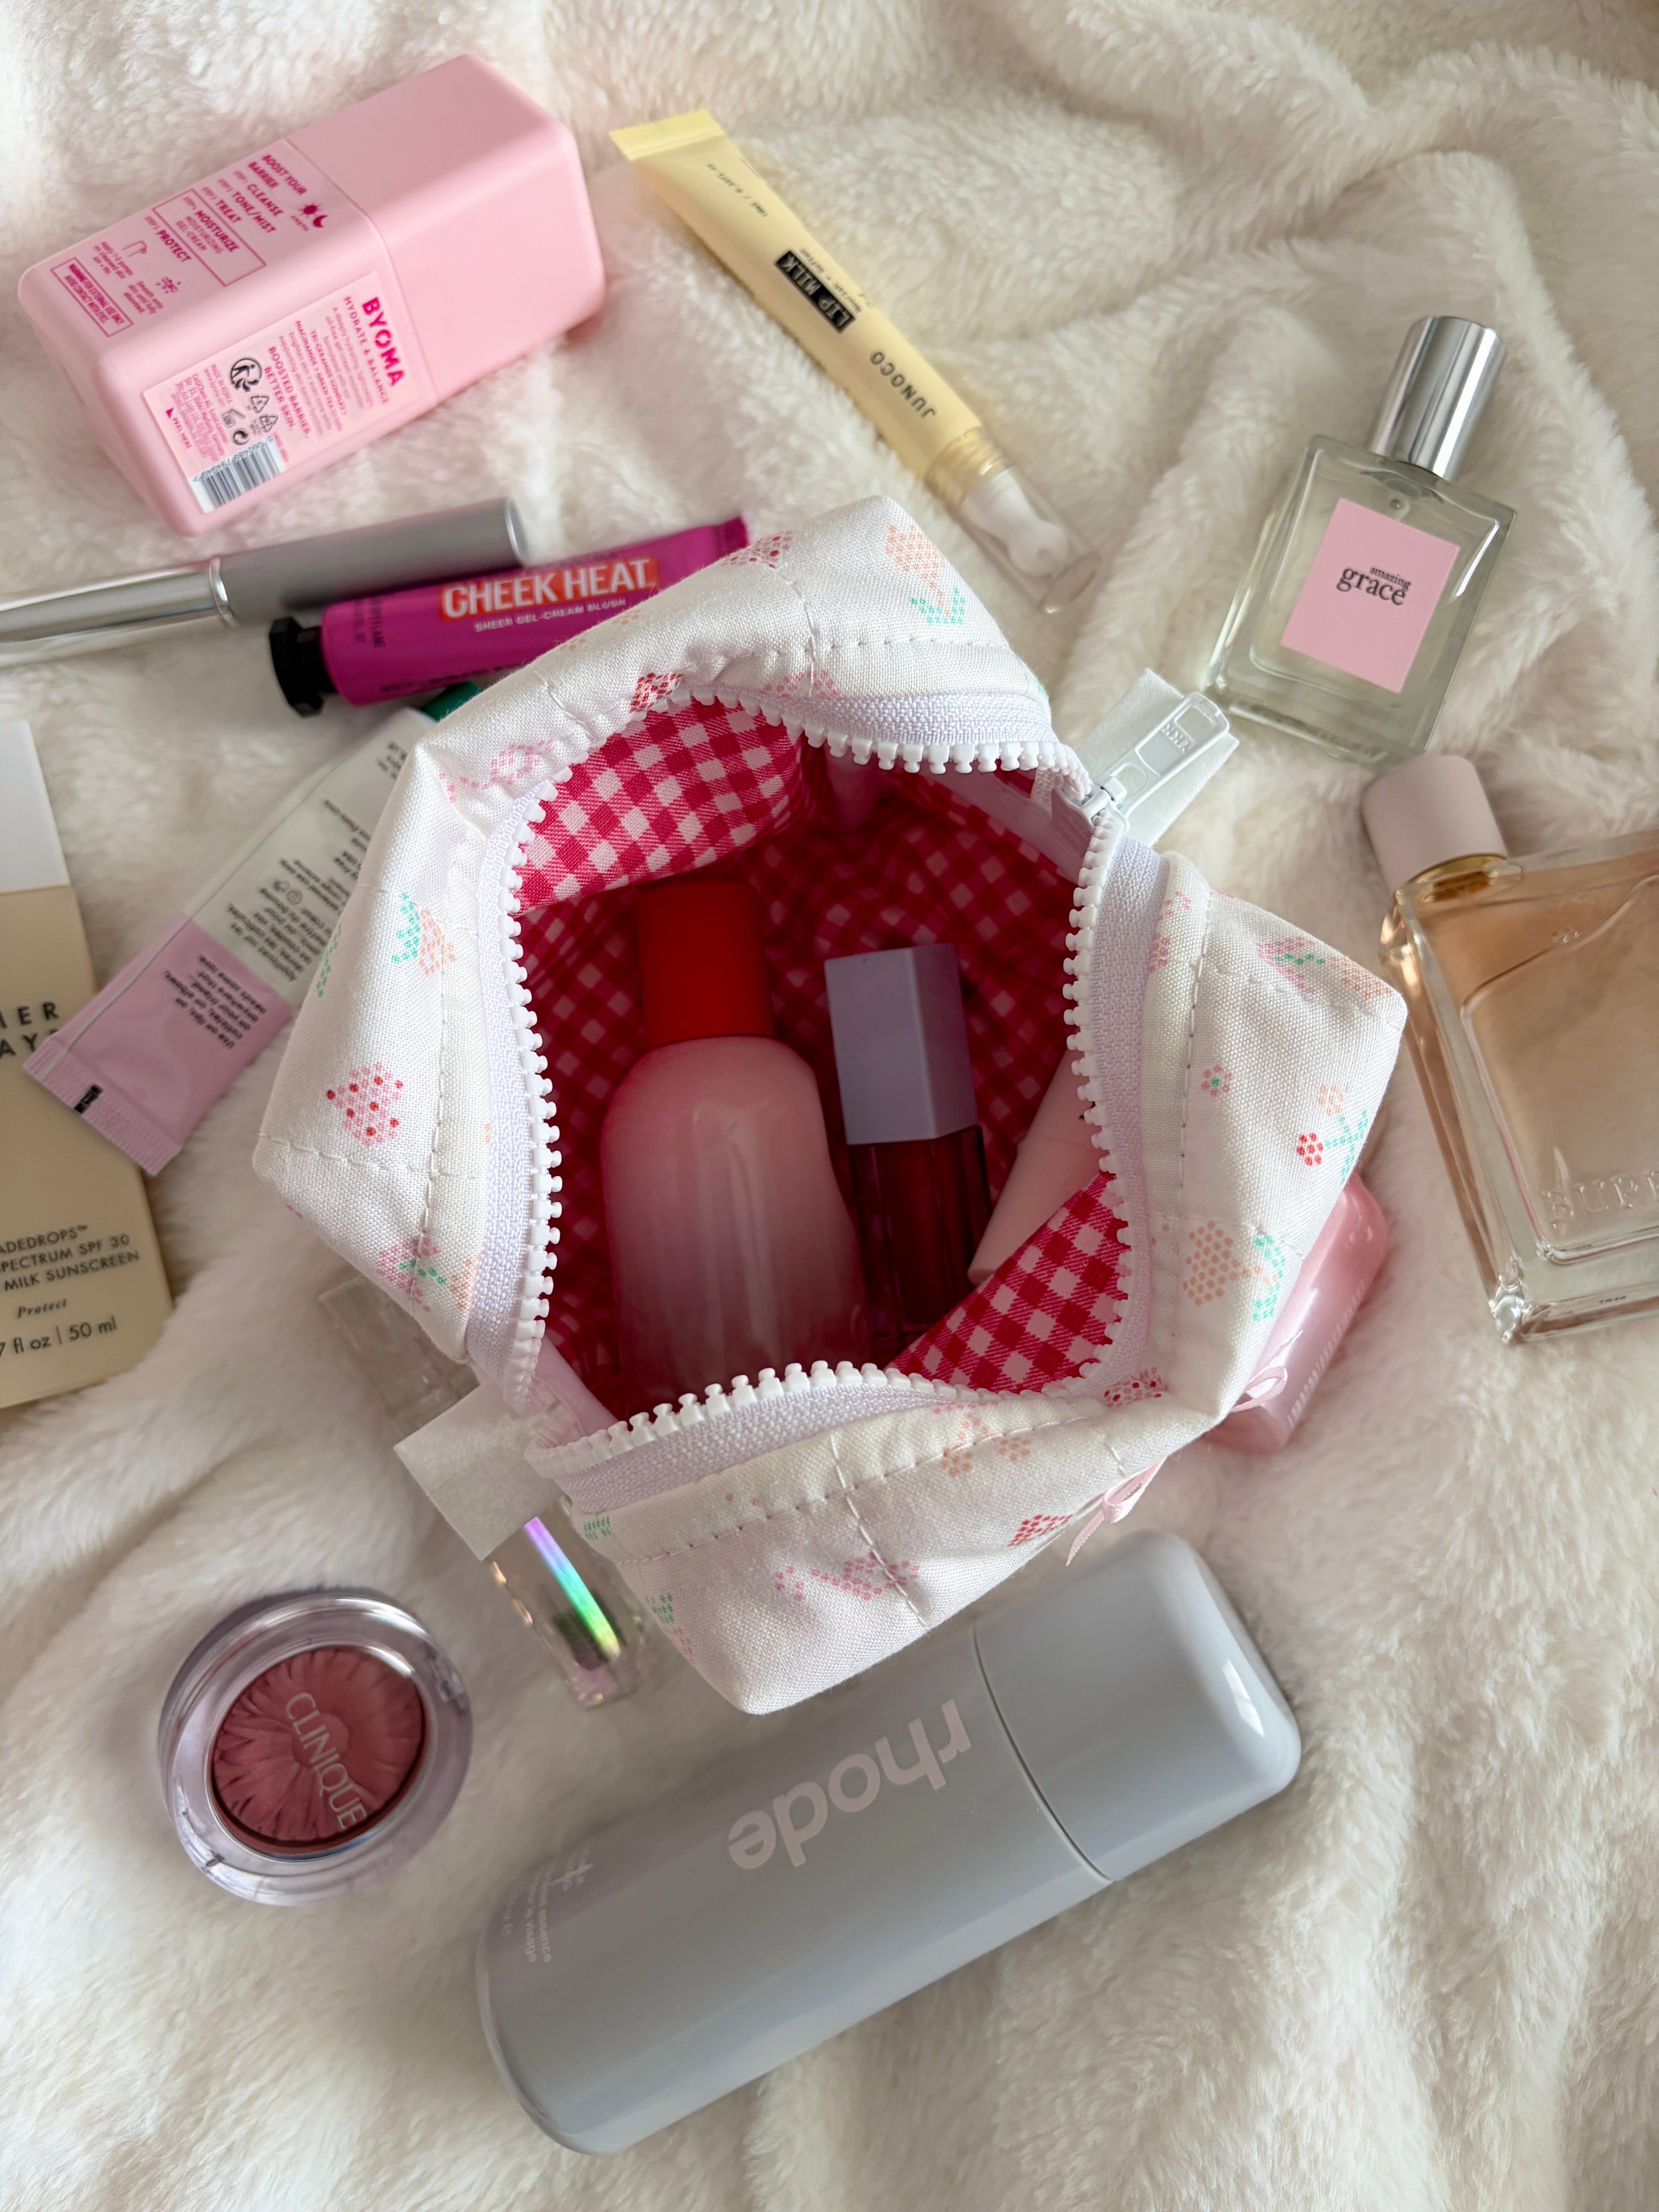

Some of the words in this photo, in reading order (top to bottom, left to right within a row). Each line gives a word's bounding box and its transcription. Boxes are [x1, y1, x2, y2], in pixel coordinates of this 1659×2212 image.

[248, 161, 278, 188] BARRIER
[263, 154, 287, 176] BOOST
[284, 175, 306, 195] YOUR
[215, 200, 241, 223] TREAT
[231, 192, 275, 233] TONE/MIST
[247, 184, 282, 216] CLEANSE
[156, 230, 191, 262] PROTECT
[176, 221, 207, 250] GEL-CREAM
[185, 217, 223, 252] MOISTURIZING
[195, 211, 238, 251] MOISTURIZE
[98, 252, 118, 270] cleansed
[780, 254, 821, 295] MILK
[73, 286, 92, 302] CONTACT
[88, 302, 101, 313] WITH
[82, 280, 94, 289] FOR
[88, 289, 110, 307] EXTERNAL
[104, 306, 116, 315] USE
[816, 294, 851, 327] LIP
[278, 335, 298, 372] supporting
[295, 321, 317, 364] NIACINAMIDE
[343, 297, 368, 343] HYDRATE
[367, 360, 389, 403] BALANCE
[362, 297, 405, 386] BYOMA
[263, 367, 285, 402] BETTER
[269, 347, 293, 393] BOOSTED
[870, 350, 937, 419] JUNOCO
[172, 417, 184, 433] PEEL
[180, 433, 192, 448] HERE
[441, 571, 560, 619] CHEEK
[561, 557, 653, 601] HEAT
[1336, 568, 1407, 606] grace
[1370, 566, 1412, 592] amazing
[473, 616, 514, 632] SHEER
[515, 605, 584, 625] GEL-CREAM
[586, 597, 627, 612] BLUSH
[257, 887, 290, 914] baume
[307, 884, 340, 911] external
[262, 906, 286, 926] pour
[285, 911, 301, 926] du
[298, 922, 329, 947] mettre
[197, 970, 216, 989] that
[217, 971, 239, 993] some
[218, 984, 258, 1024] anywhere
[219, 1001, 239, 1022] your
[239, 990, 265, 1016] needs
[205, 1022, 218, 1036] on
[216, 1031, 235, 1051] Use
[237, 1018, 251, 1032] on
[0, 1029, 58, 1058] AY
[0, 1247, 73, 1274] PECTRUM
[79, 1239, 102, 1256] SPF
[110, 1233, 130, 1249] 30
[5, 1273, 40, 1291] MILK
[46, 1250, 140, 1281] SUNSCREEN
[17, 1298, 67, 1319] Protect
[13, 1336, 24, 1354] fl
[30, 1336, 51, 1350] oz
[69, 1321, 92, 1341] 50
[98, 1314, 118, 1334] ml
[285, 1692, 368, 1832] CLINIQUE
[728, 1698, 973, 1871] rhode
